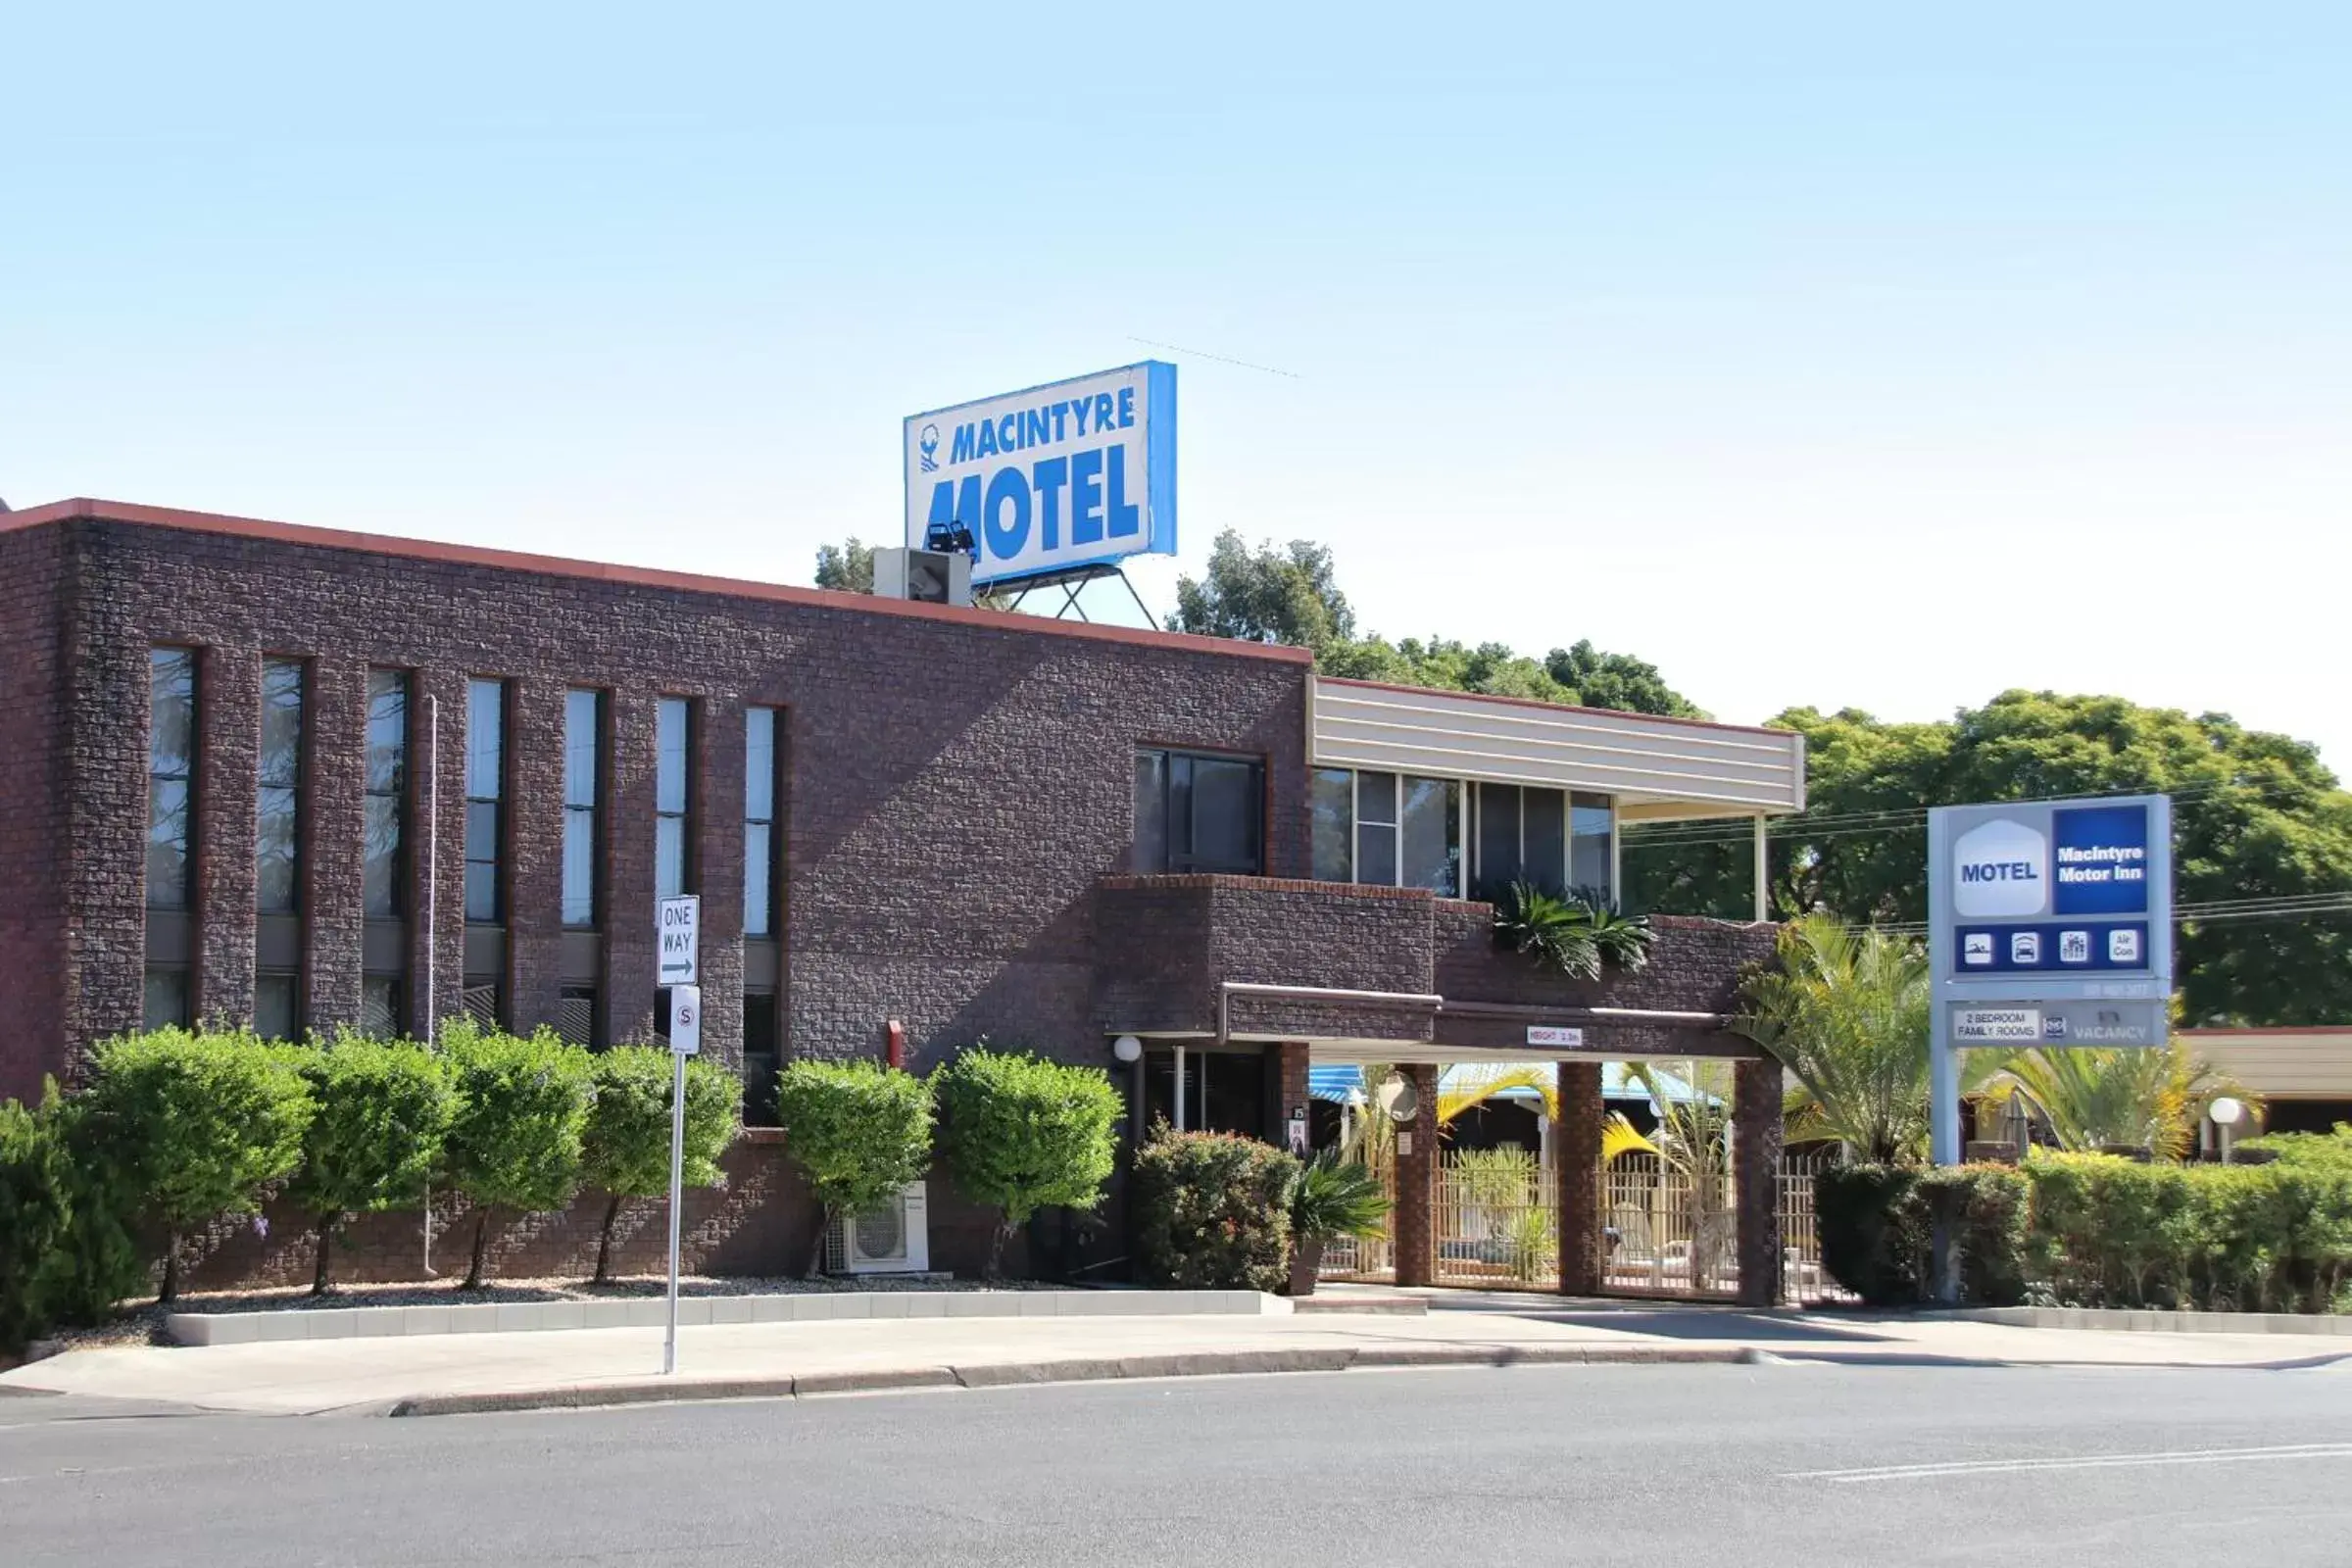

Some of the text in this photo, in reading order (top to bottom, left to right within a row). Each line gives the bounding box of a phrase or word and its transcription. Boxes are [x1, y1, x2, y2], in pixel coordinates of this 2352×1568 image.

[950, 386, 1135, 466] MACINTYRE
[921, 444, 1139, 564] MOTEL
[1961, 861, 2038, 883] MOTEL
[2058, 864, 2143, 883] Motor Inn
[665, 906, 691, 926] ONE
[663, 932, 692, 954] WAY
[680, 1008, 691, 1023] S
[1966, 1013, 2026, 1023] 2 BEDROOM
[1957, 1025, 1993, 1036] FAMILY
[1996, 1025, 2035, 1036] ROOMS
[2074, 1025, 2147, 1040] VACANCY
